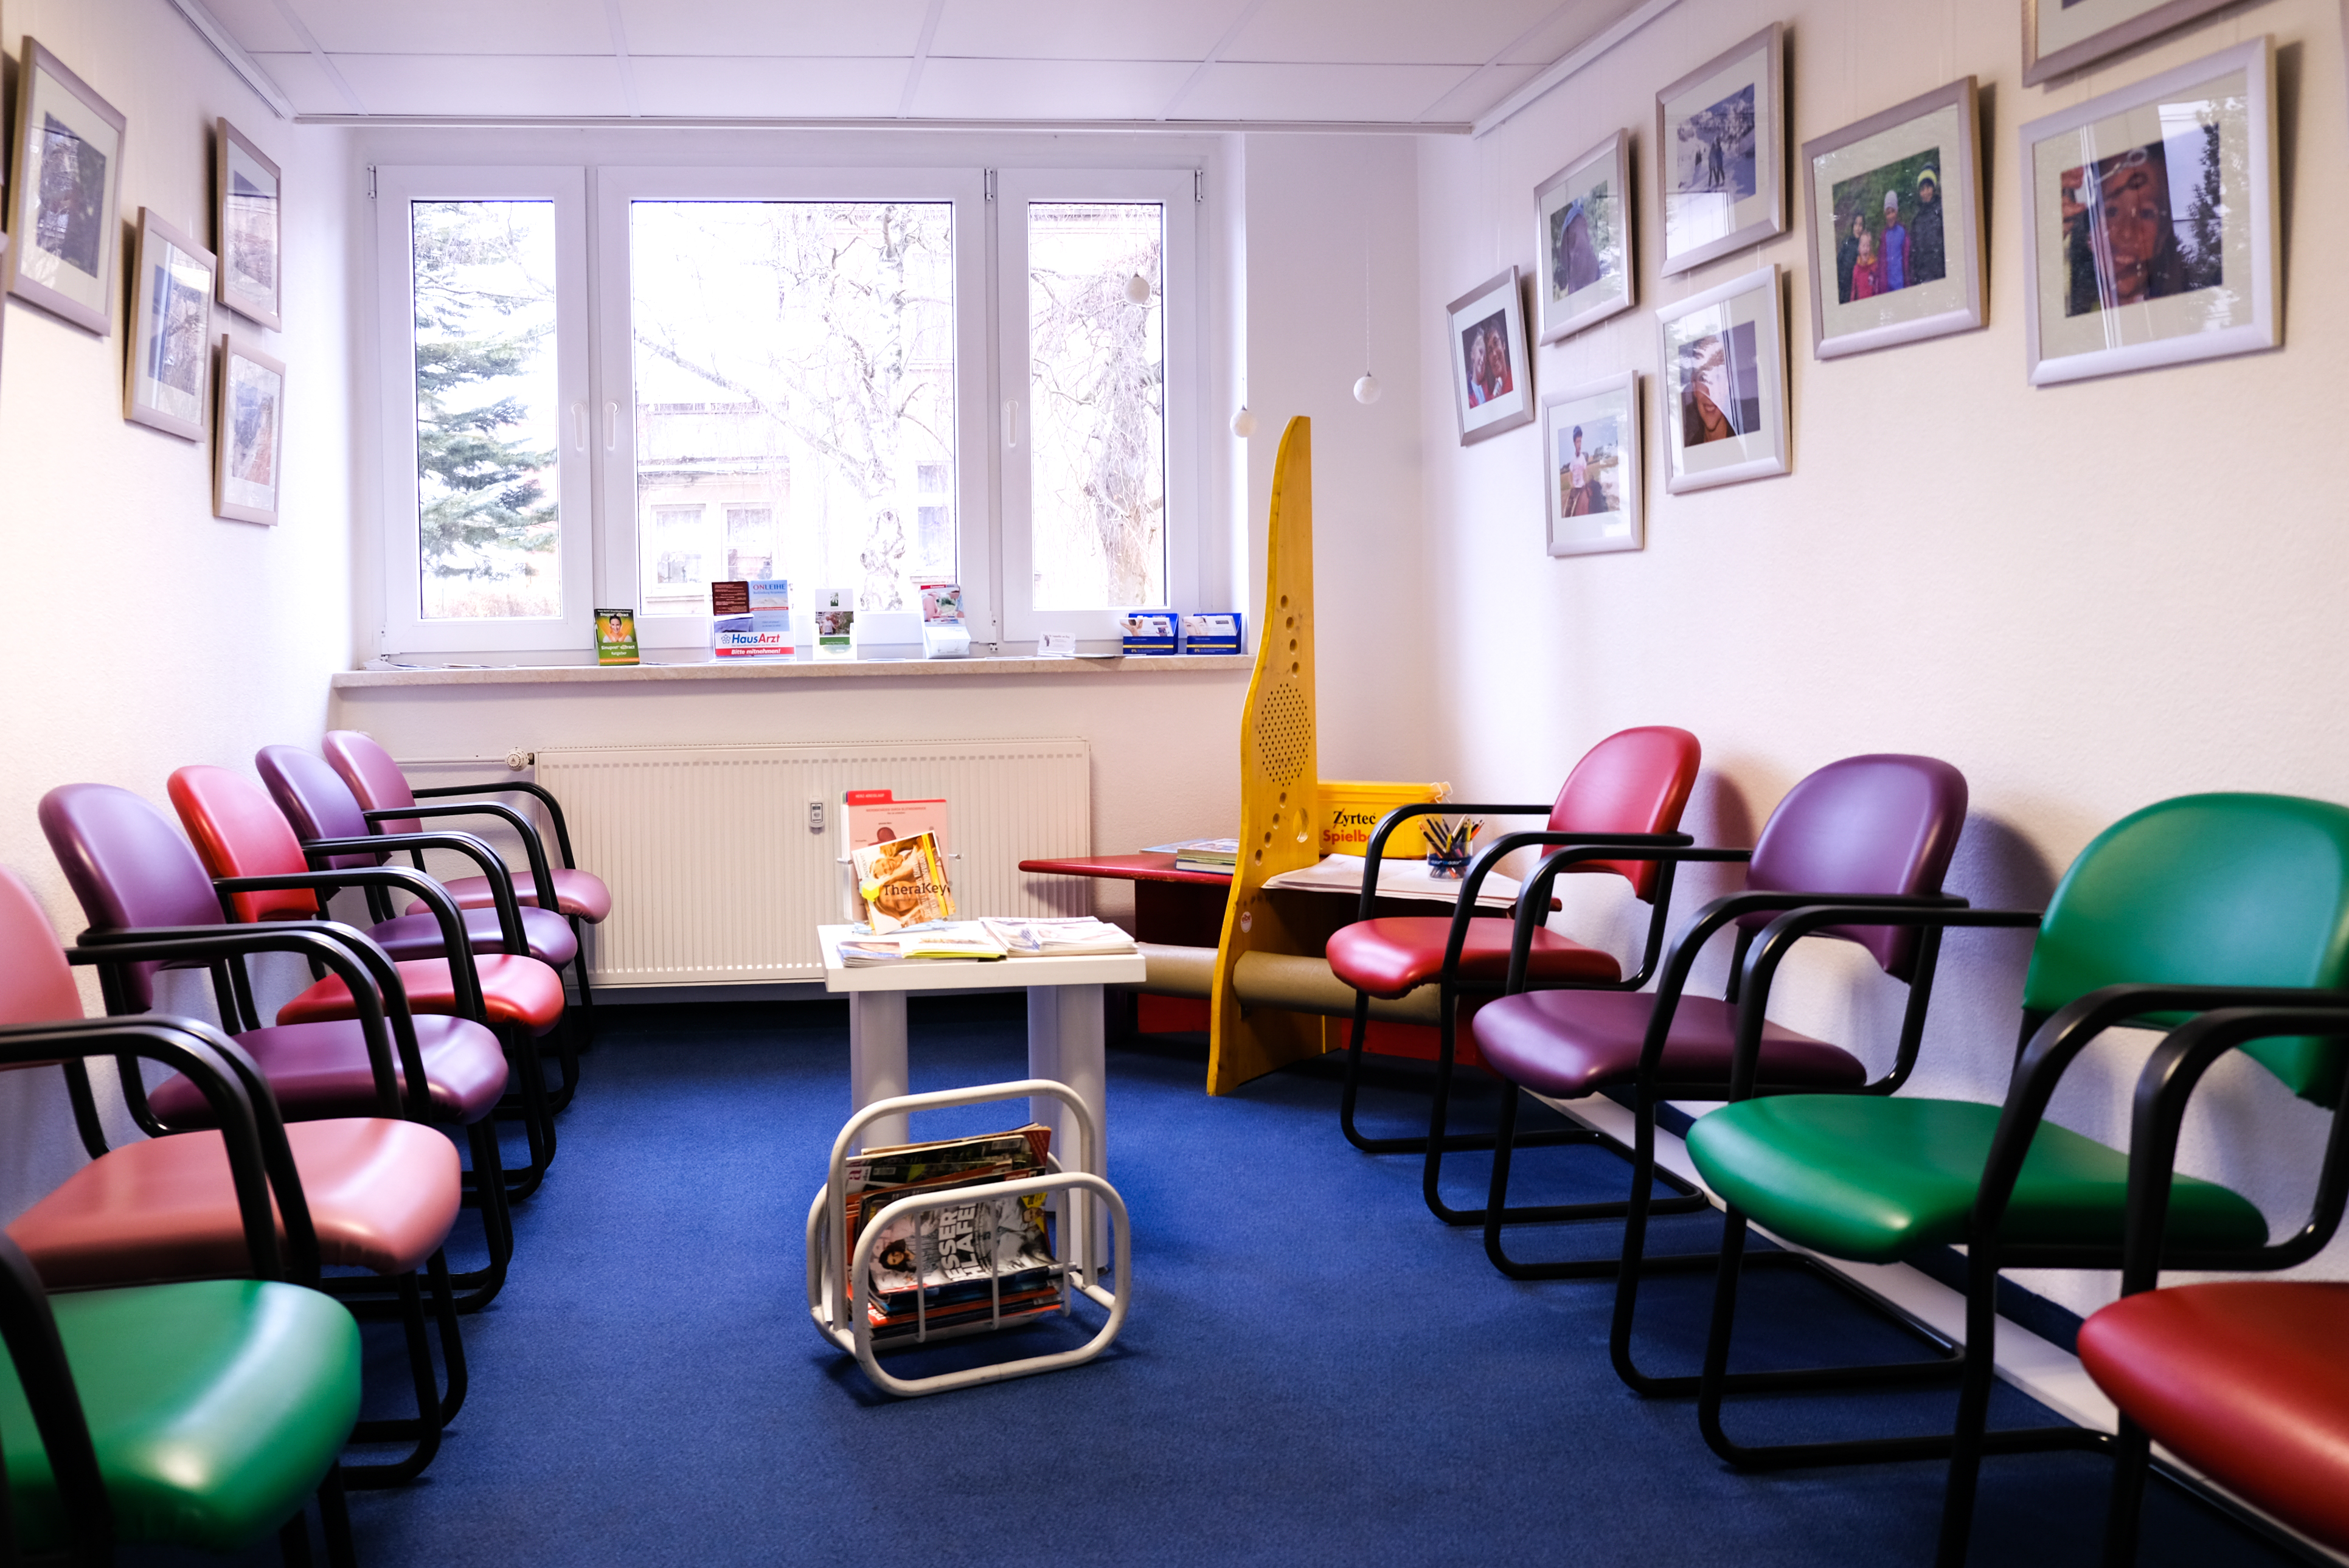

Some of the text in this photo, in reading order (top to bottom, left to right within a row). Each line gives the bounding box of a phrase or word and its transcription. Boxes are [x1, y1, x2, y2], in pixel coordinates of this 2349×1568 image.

[732, 633, 780, 644] HausArzt
[1333, 809, 1376, 827] Zyrtec
[884, 883, 947, 895] TheraKey
[939, 1210, 967, 1281] ESSER
[956, 1203, 988, 1280] HLAFE
